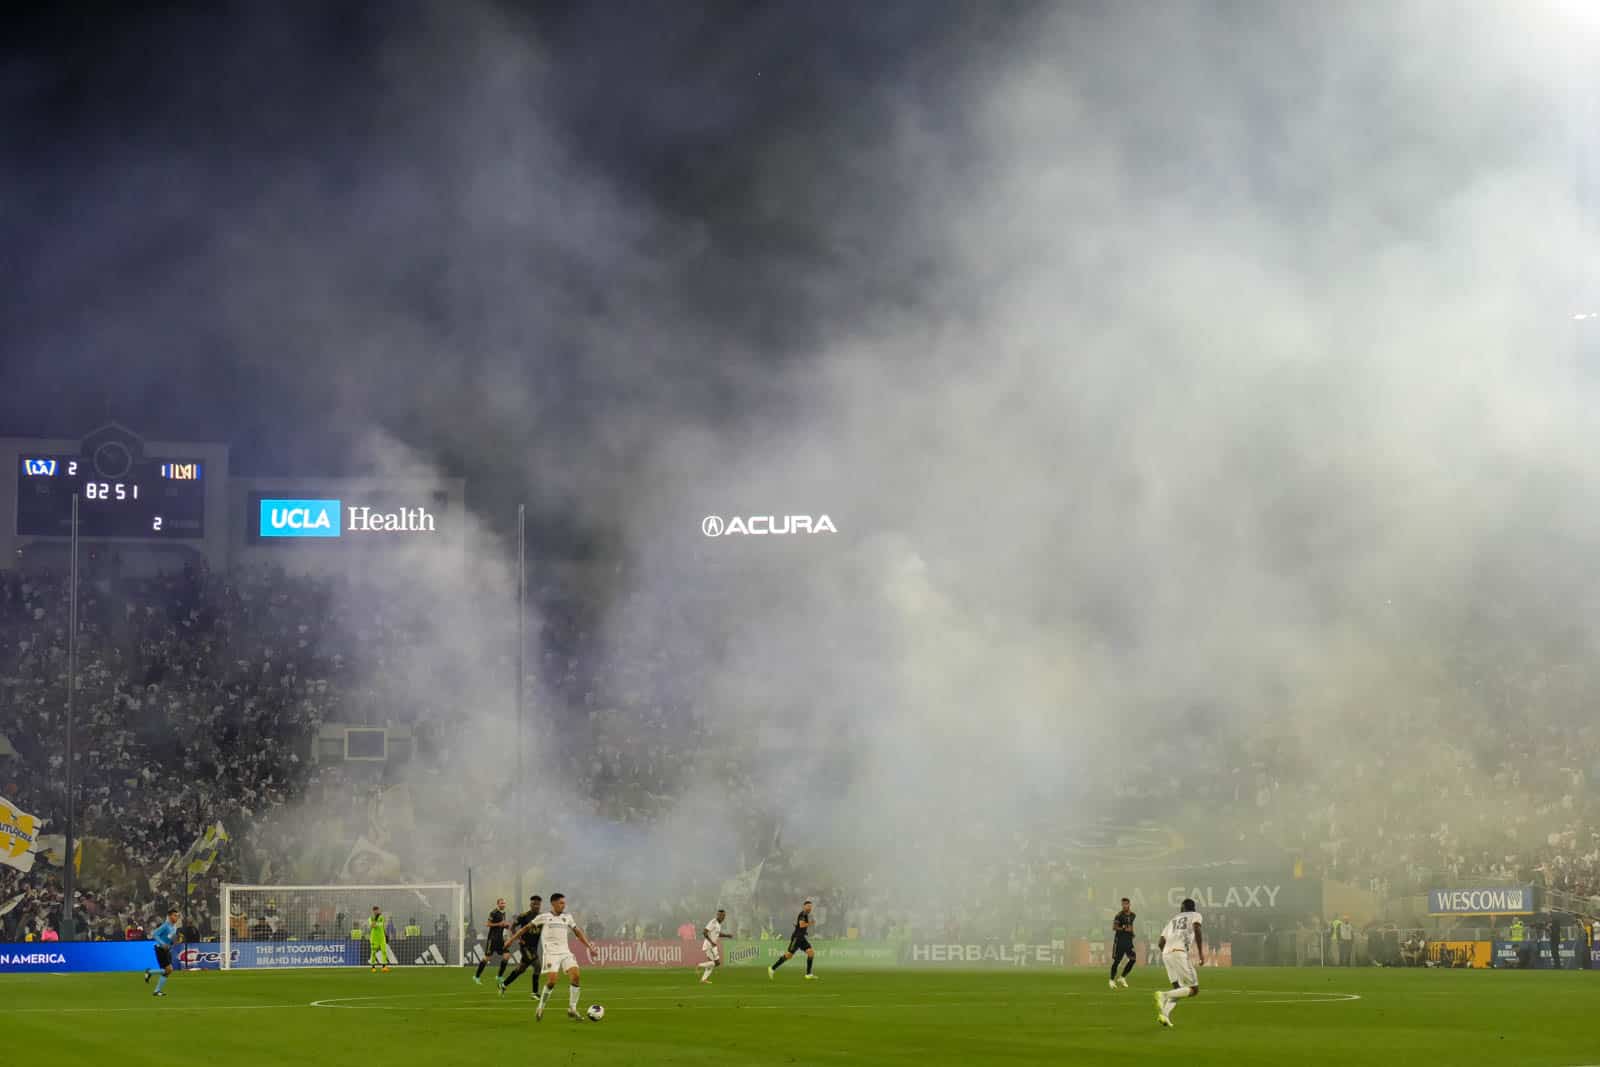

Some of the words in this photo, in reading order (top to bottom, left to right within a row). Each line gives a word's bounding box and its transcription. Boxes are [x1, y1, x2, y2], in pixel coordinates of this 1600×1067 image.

[68, 462, 77, 475] 2
[153, 517, 162, 530] 2
[271, 509, 331, 528] UCLA
[347, 507, 436, 531] Health
[724, 514, 838, 535] ACURA
[1167, 884, 1280, 908] GALAXY
[1437, 891, 1505, 910] WESCOM
[286, 944, 345, 953] TOOTHPASTE
[587, 941, 632, 965] Captain
[632, 941, 682, 964] Morgan
[912, 943, 1052, 961] HERBALFE
[12, 953, 66, 964] AMERICA
[256, 957, 289, 965] BRAND
[291, 956, 301, 965] IN
[303, 955, 345, 964] AMERICA
